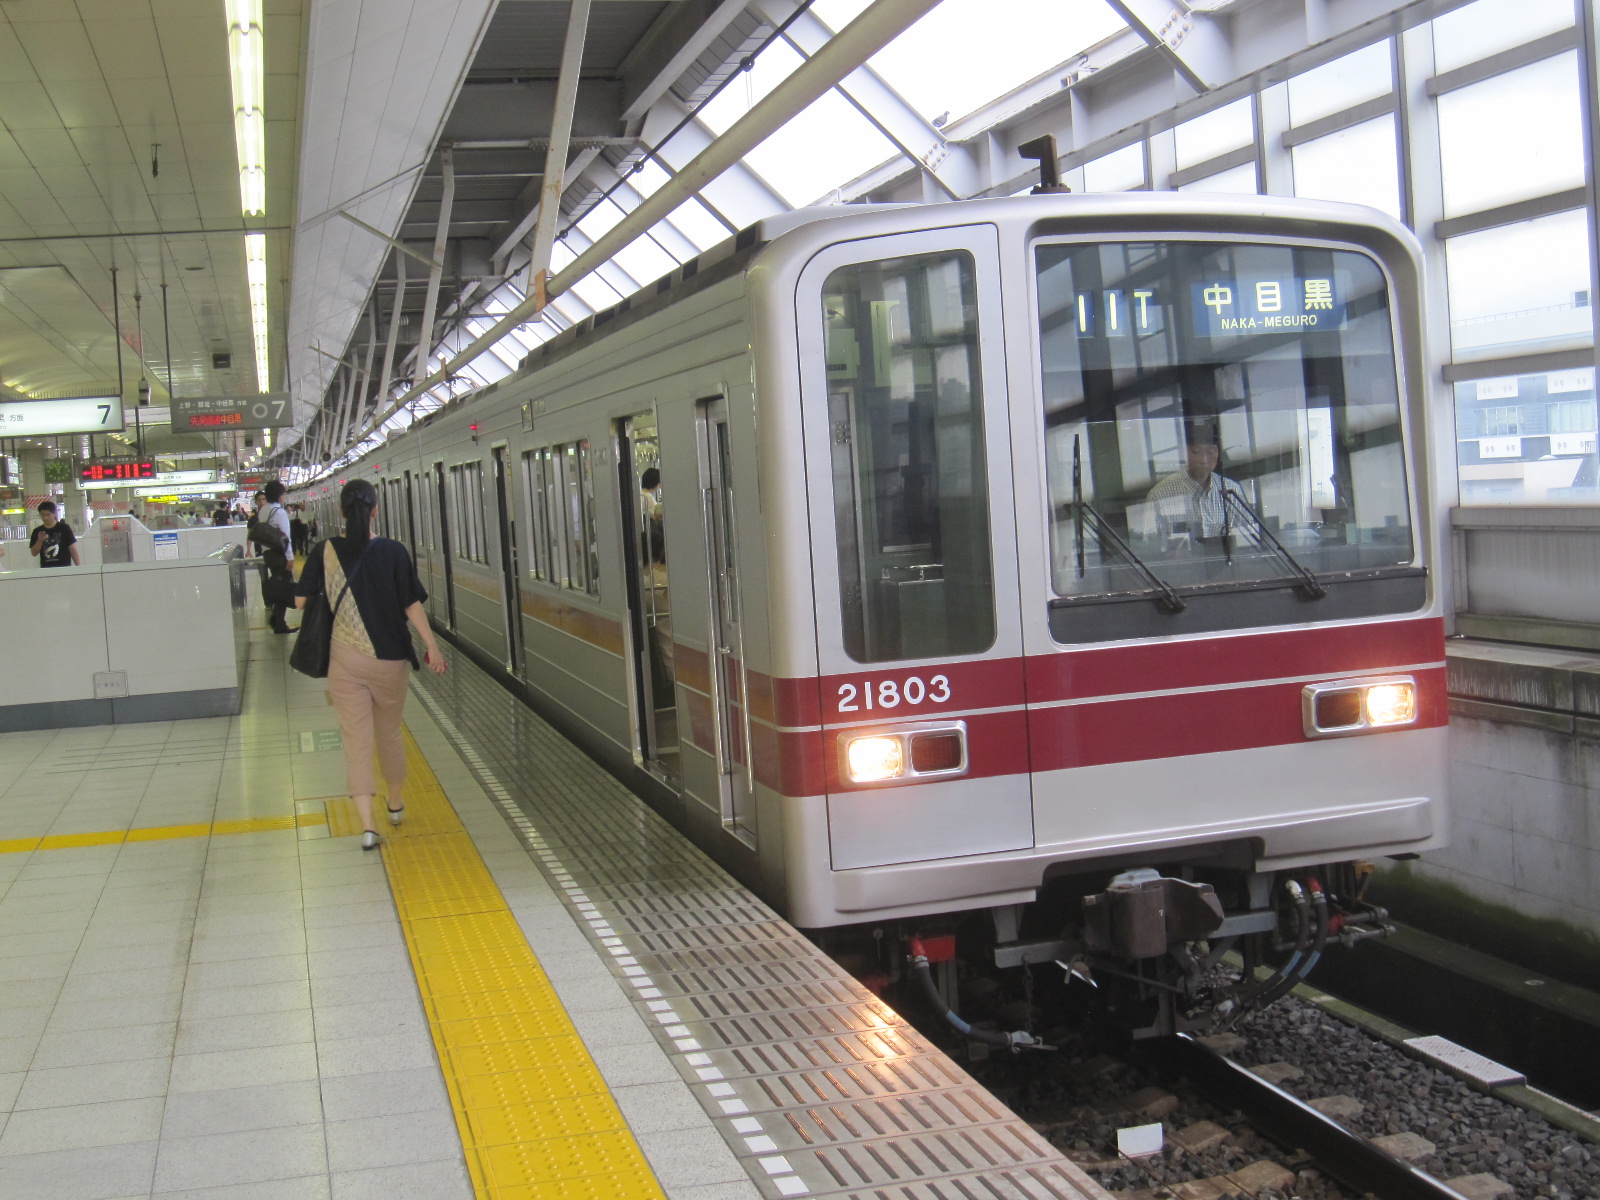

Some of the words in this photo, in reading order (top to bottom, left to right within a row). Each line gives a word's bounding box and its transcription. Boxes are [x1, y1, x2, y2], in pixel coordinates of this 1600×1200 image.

[1203, 279, 1333, 315] 中目黒
[1220, 315, 1318, 330] NAKA-MEGURO
[97, 404, 111, 425] 7
[837, 674, 951, 713] 21803
